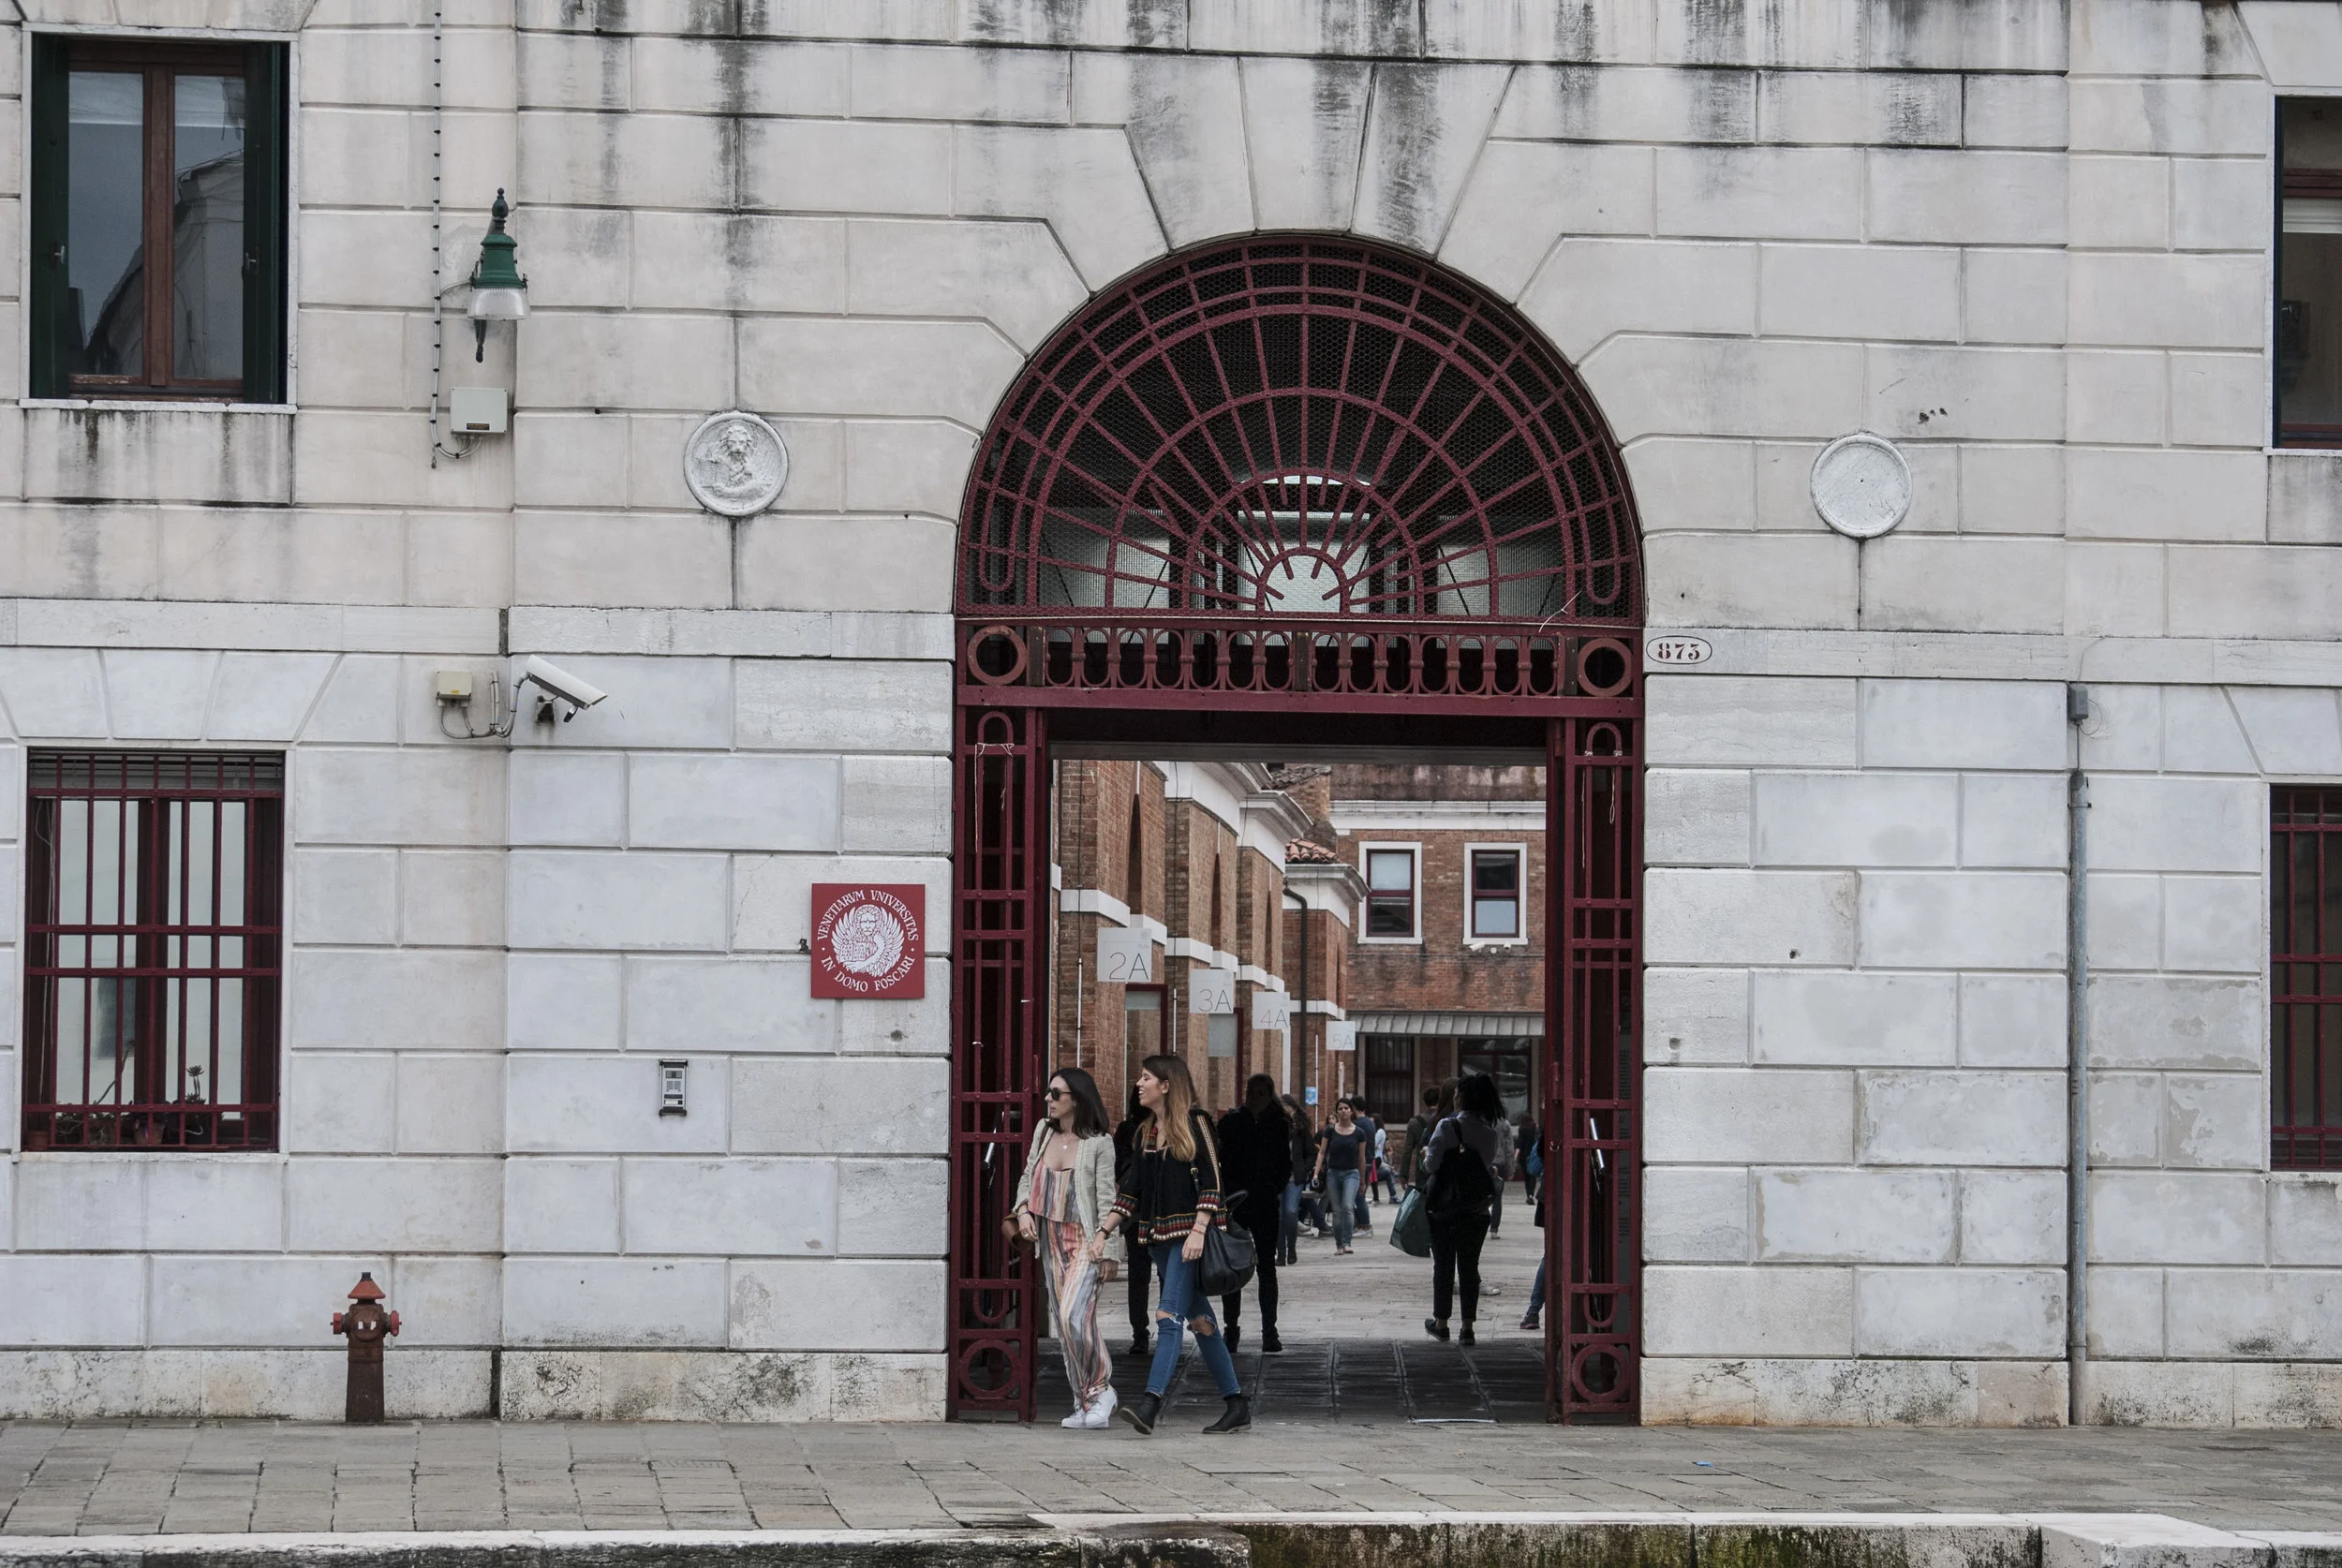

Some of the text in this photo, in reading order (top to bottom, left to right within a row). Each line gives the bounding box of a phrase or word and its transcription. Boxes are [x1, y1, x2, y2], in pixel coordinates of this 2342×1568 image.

[1658, 643, 1700, 660] 873
[817, 889, 919, 941] VENETIARVM VNIVERSITAS
[821, 954, 915, 992] IN DOMO FOSCARI
[1109, 952, 1149, 980] 2A
[1198, 988, 1232, 1013] 3A
[1260, 1009, 1288, 1028] 4A
